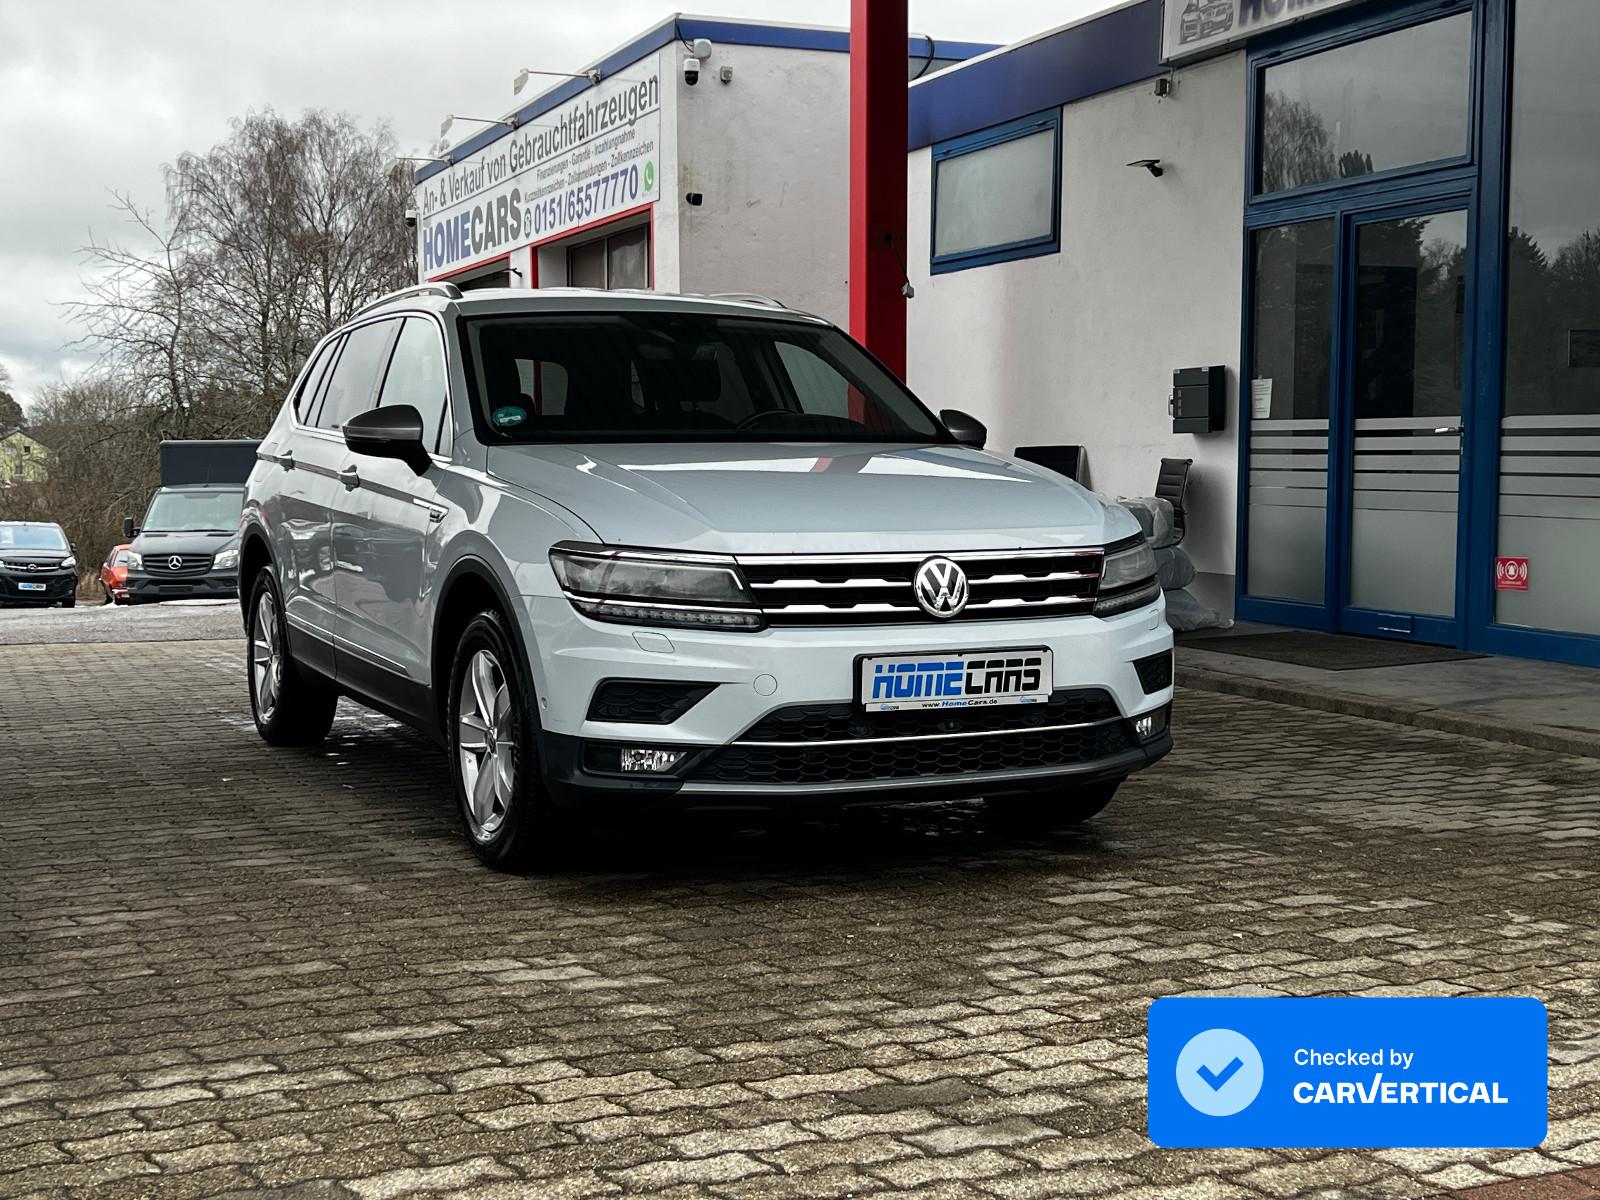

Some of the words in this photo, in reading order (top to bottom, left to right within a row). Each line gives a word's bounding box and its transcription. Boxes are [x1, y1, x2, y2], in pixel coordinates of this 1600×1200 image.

[423, 186, 438, 216] An-
[448, 156, 486, 203] Verkauf
[487, 153, 507, 185] von
[509, 74, 659, 173] Gebrauchtfahrzeugen
[423, 188, 522, 272] HOMECARS
[534, 163, 639, 235] 0151/65577770
